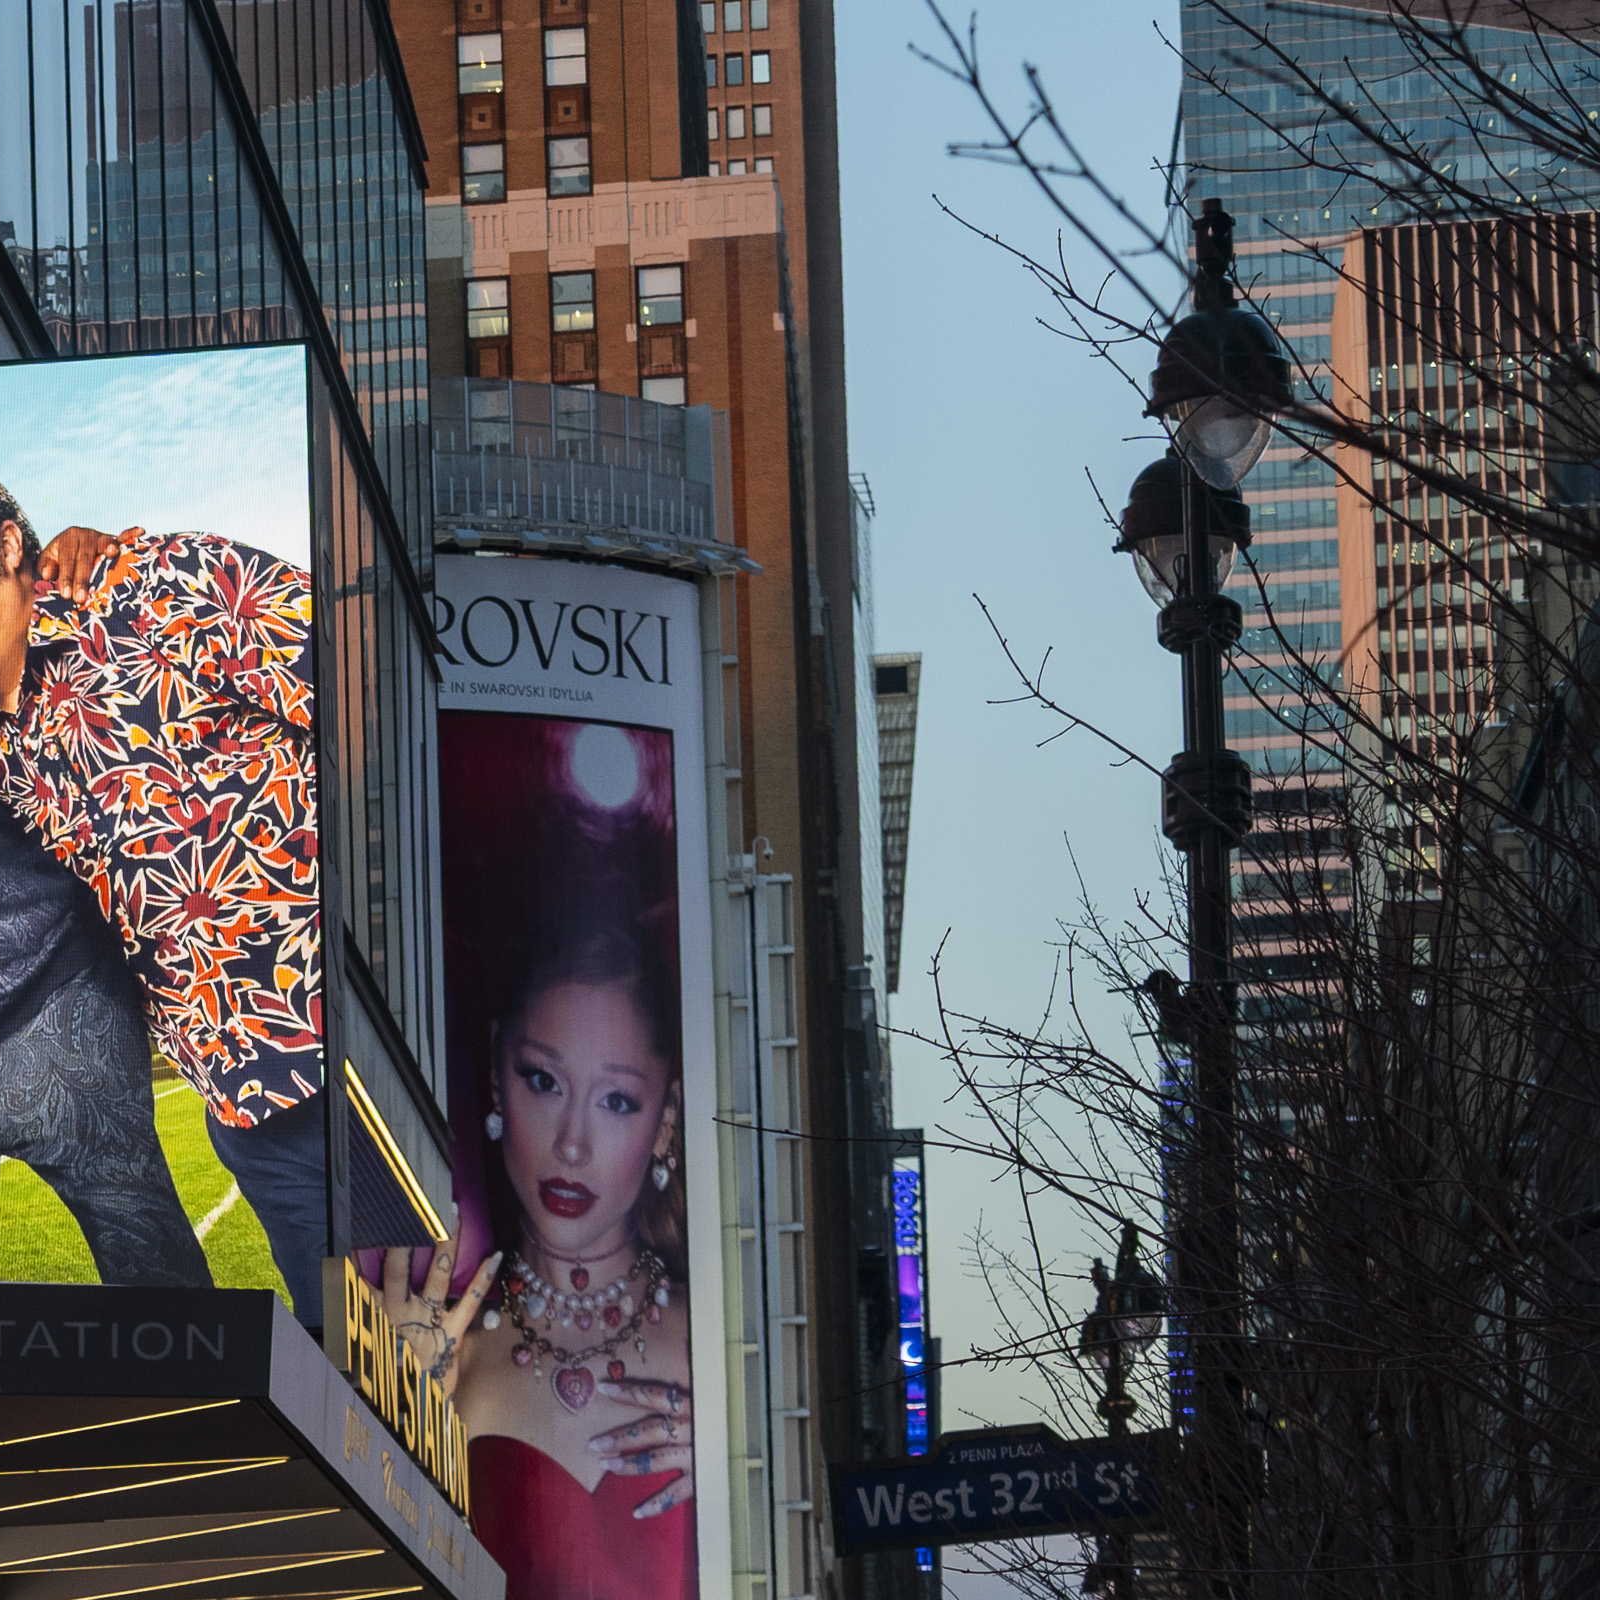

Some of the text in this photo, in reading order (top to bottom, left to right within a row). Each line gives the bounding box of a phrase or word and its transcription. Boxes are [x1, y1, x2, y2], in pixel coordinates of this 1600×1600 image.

[434, 595, 672, 686] ROVSKI
[451, 681, 465, 694] IN
[469, 683, 545, 698] SWAROVSKI
[549, 686, 594, 702] IDYLLIA
[344, 1255, 399, 1433] PENN
[403, 1338, 470, 1518] STATION
[960, 1447, 997, 1463] PENN
[1000, 1442, 1046, 1459] PLAZA
[856, 1460, 1140, 1528] West 32nd St
